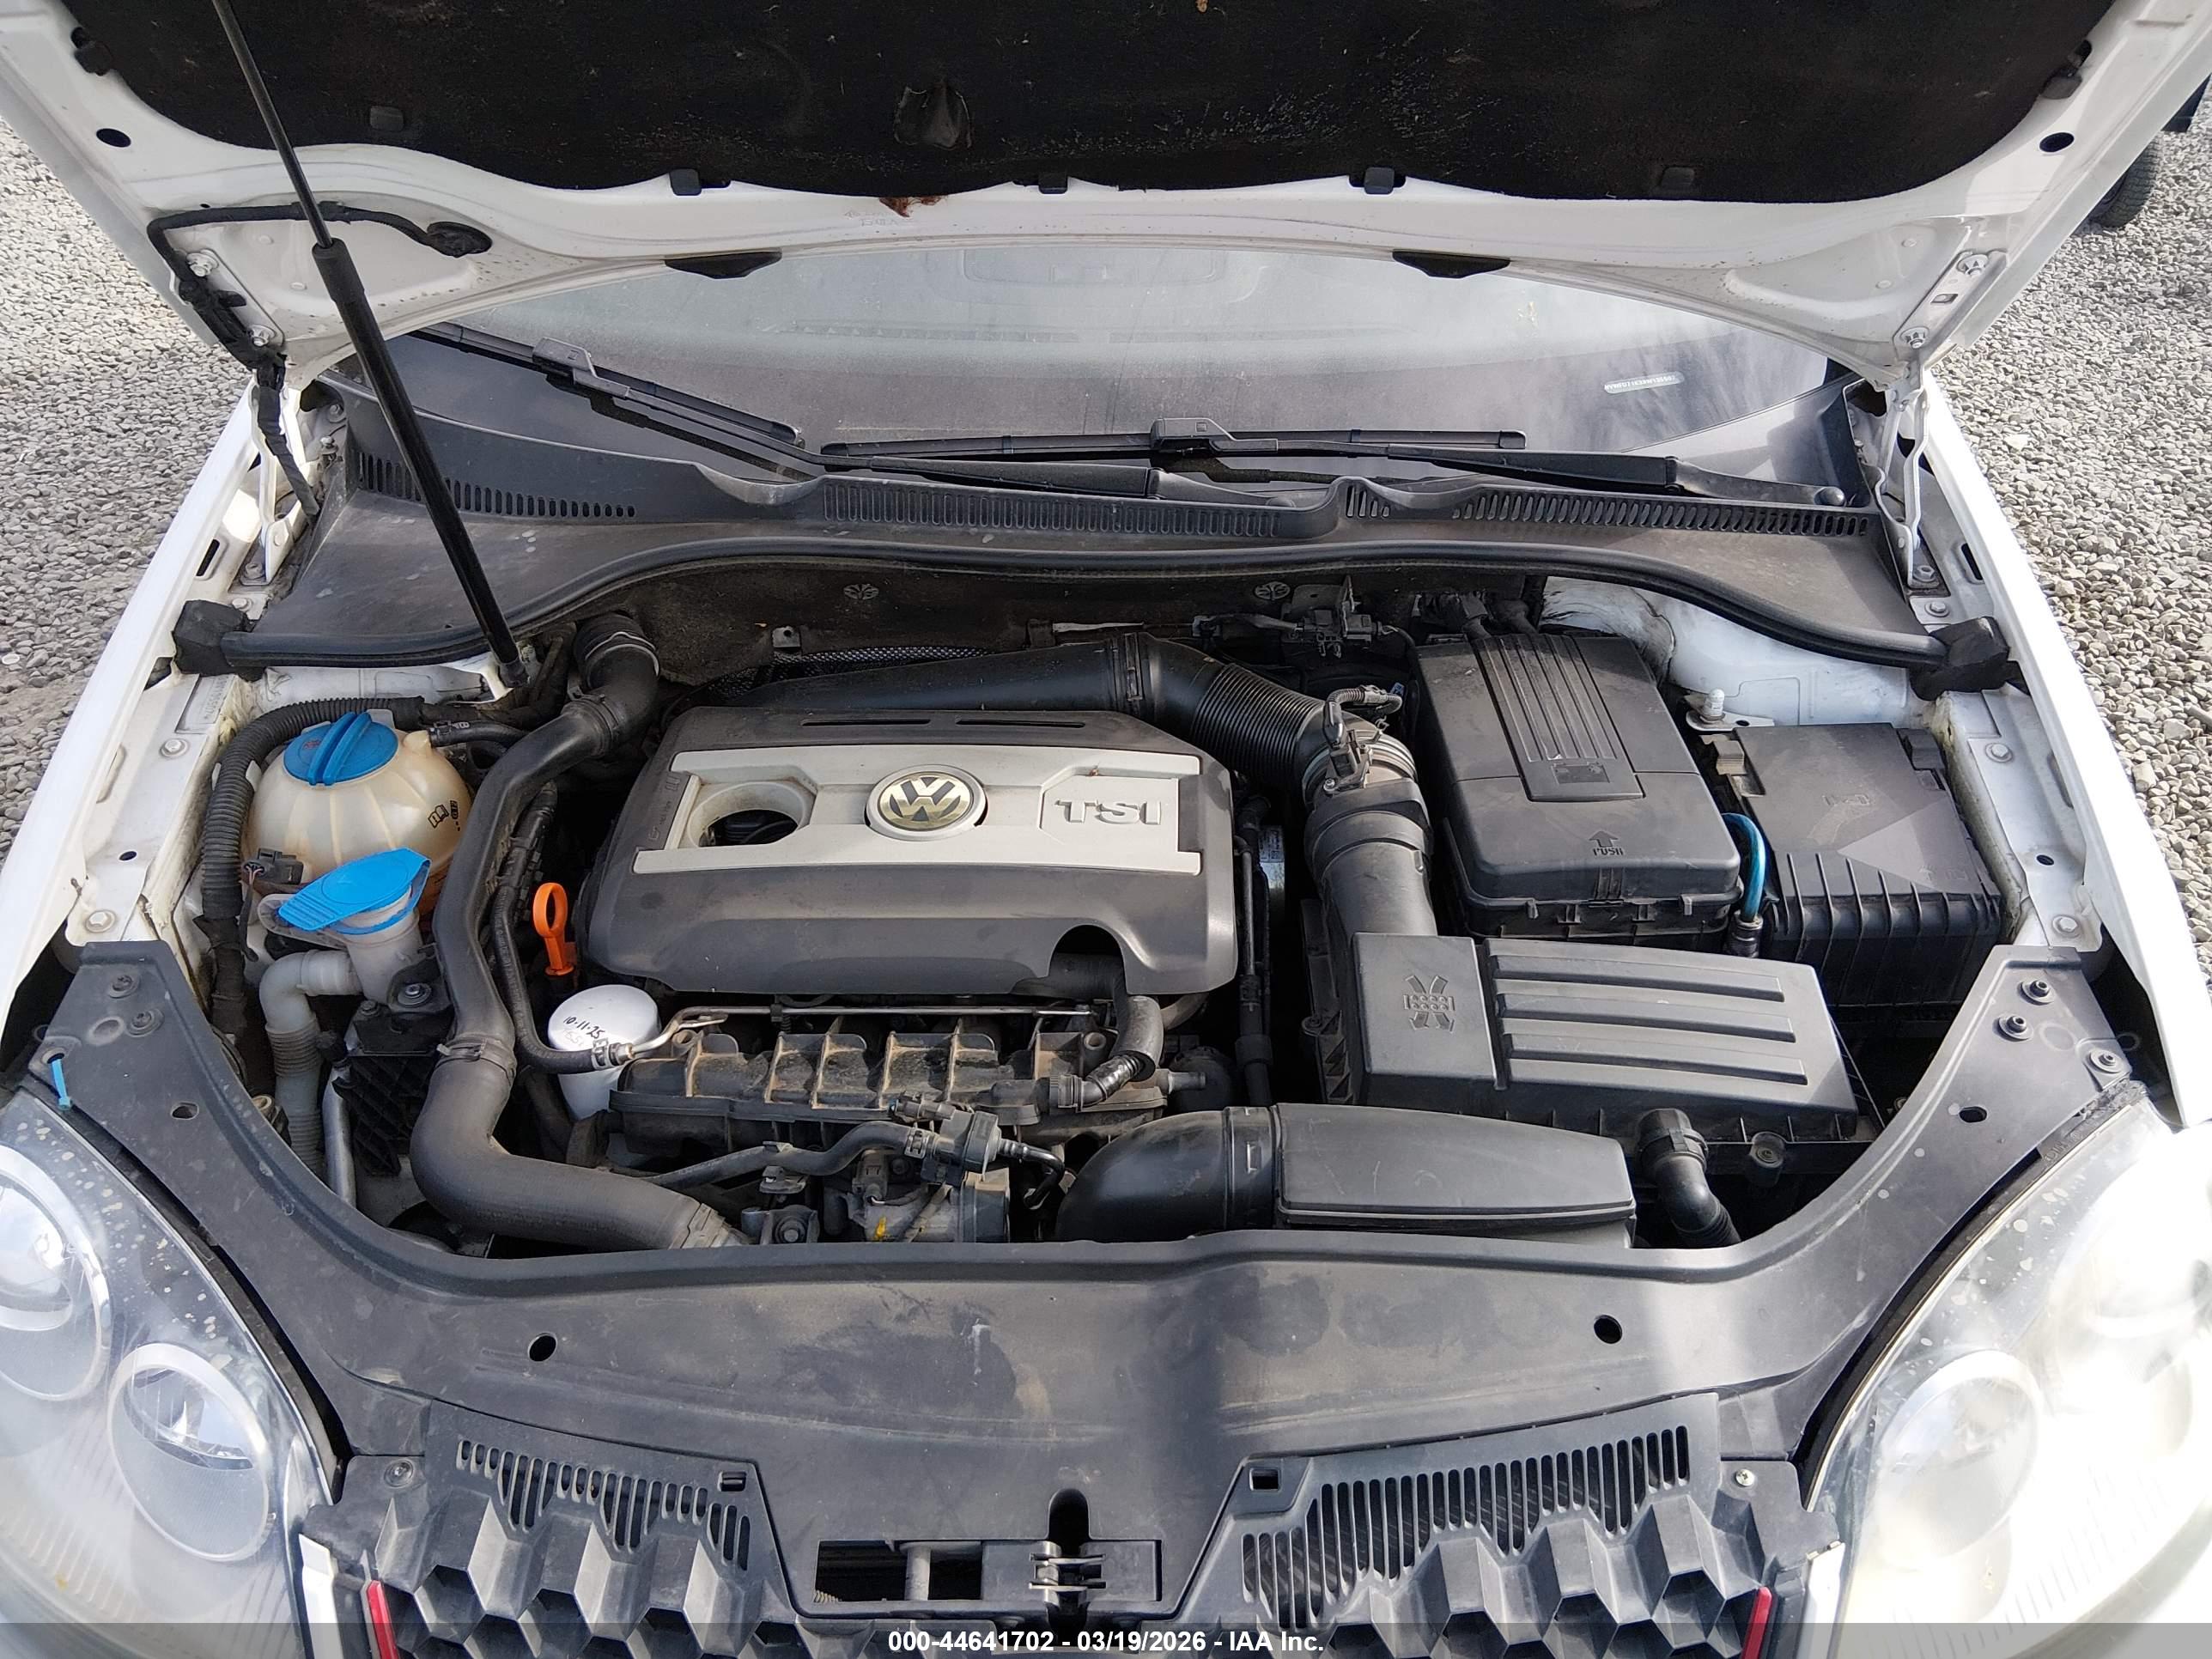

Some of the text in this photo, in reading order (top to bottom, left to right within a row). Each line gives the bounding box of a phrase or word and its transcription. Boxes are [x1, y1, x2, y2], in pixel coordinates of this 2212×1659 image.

[878, 771, 974, 831] VW
[1055, 797, 1162, 825] TSI
[1593, 847, 1624, 856] PUSH
